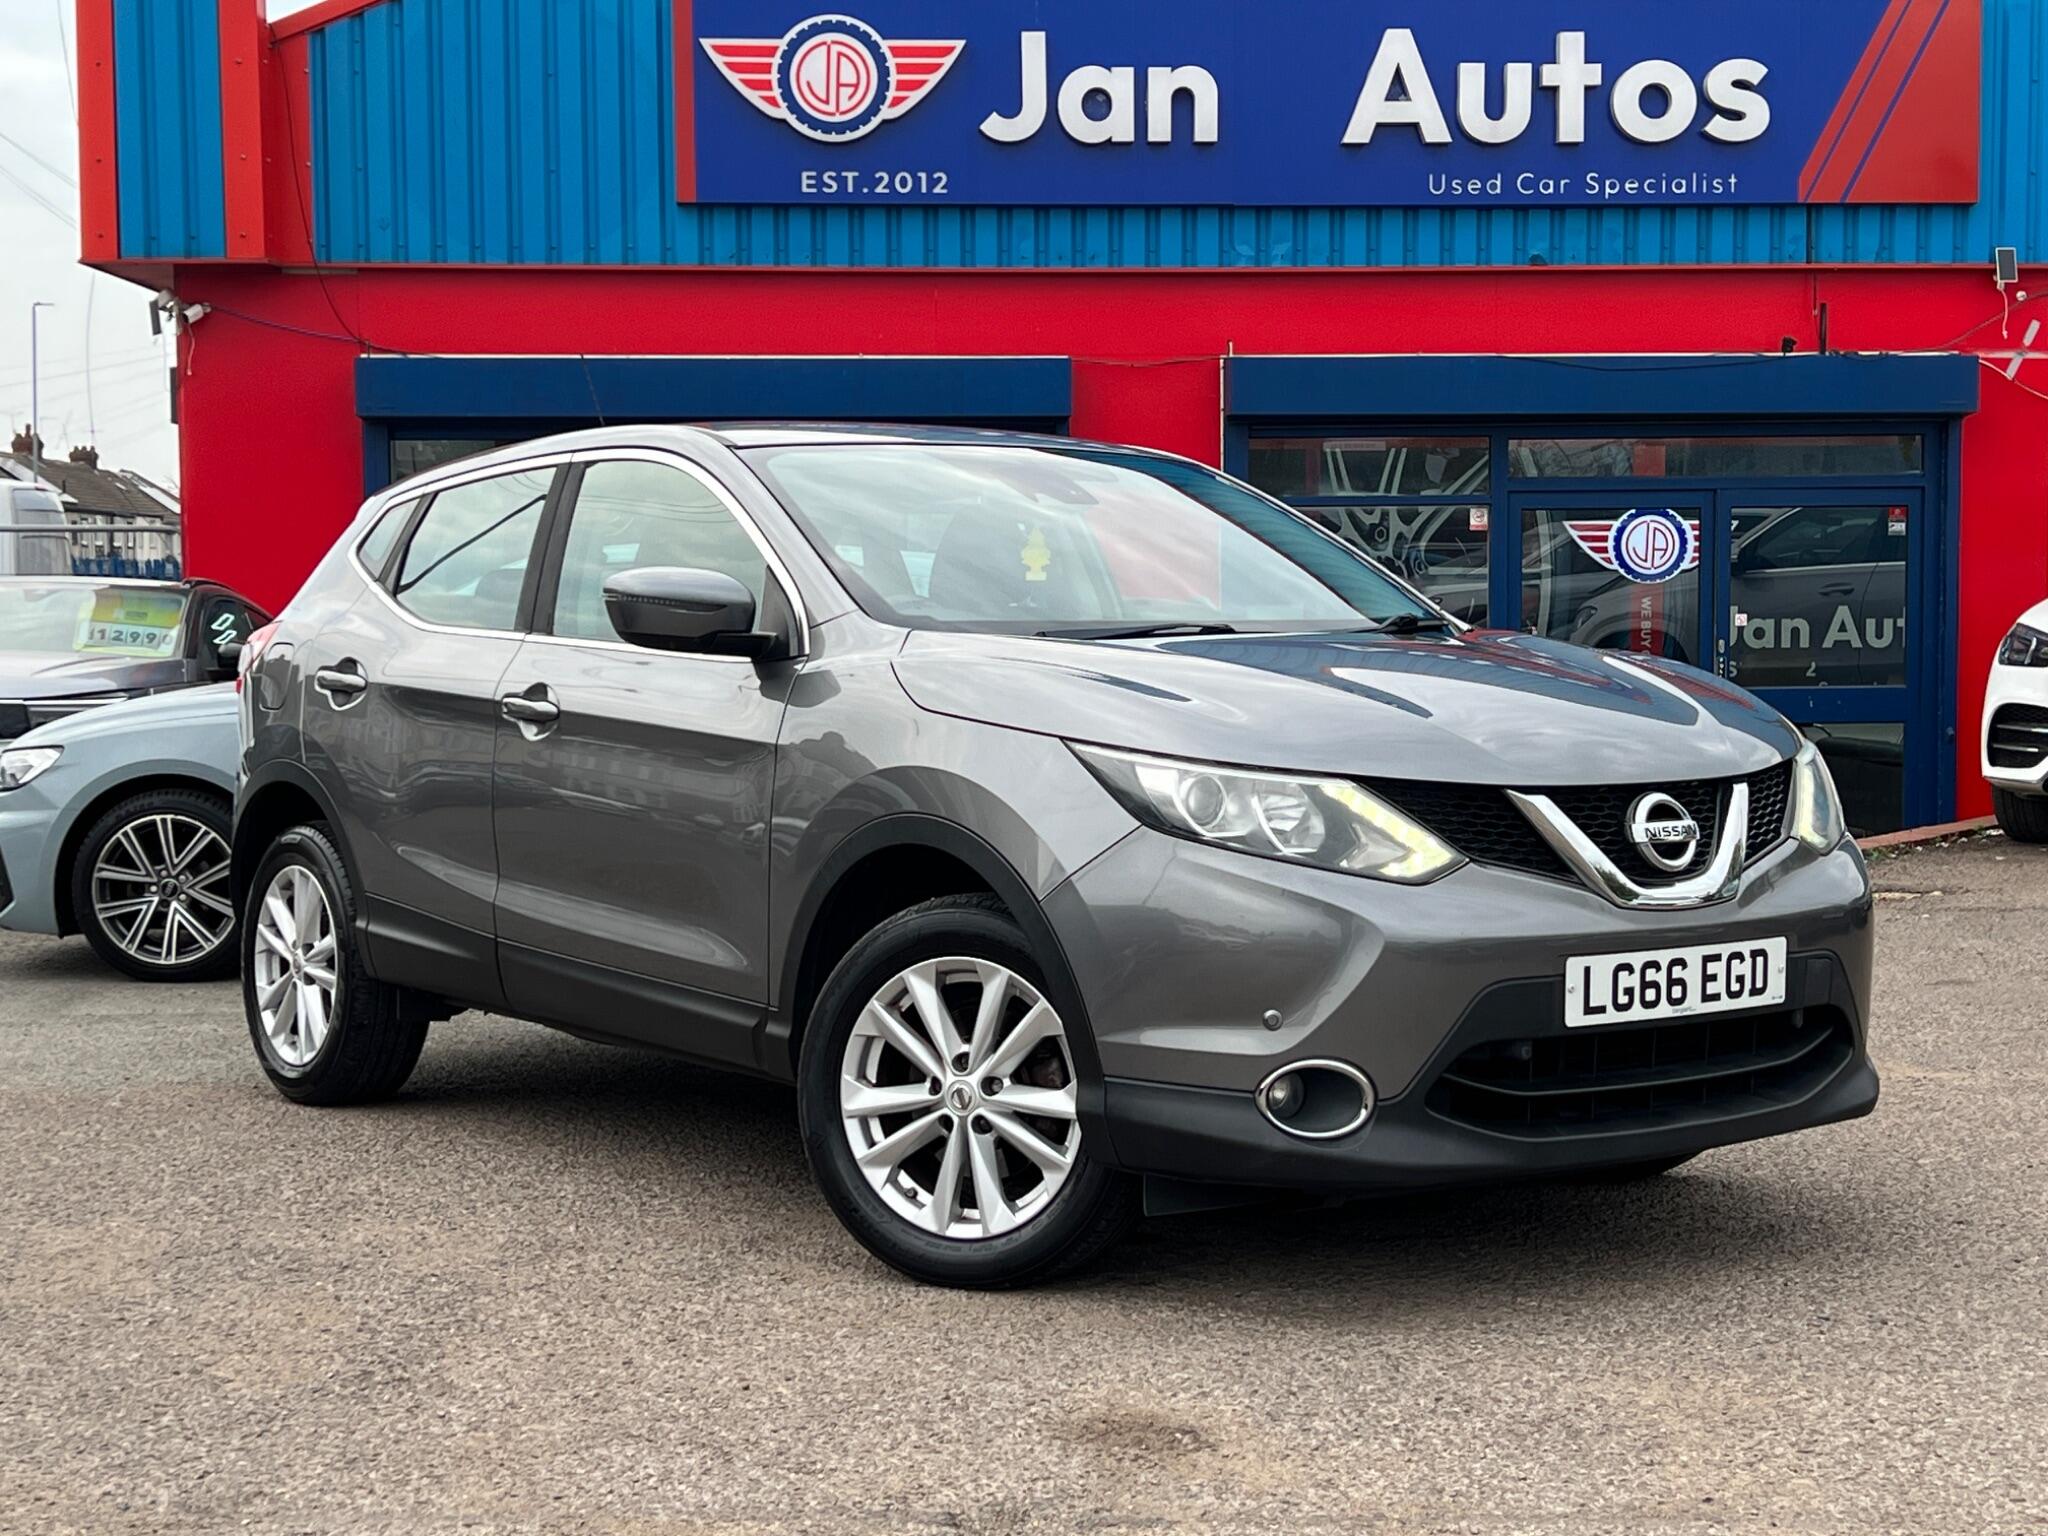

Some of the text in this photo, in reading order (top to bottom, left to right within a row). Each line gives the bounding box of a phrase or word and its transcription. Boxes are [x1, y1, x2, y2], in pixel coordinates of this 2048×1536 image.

[979, 28, 1772, 144] Jan Autos
[801, 171, 949, 194] EST.2012
[1429, 172, 1738, 200] Used Car Specialist
[1640, 596, 1653, 618] WE
[1640, 620, 1653, 649] BUY
[1729, 605, 1810, 649] Jan
[1645, 823, 1697, 839] NISSAN
[1583, 948, 1769, 1016] LG66 EGD
